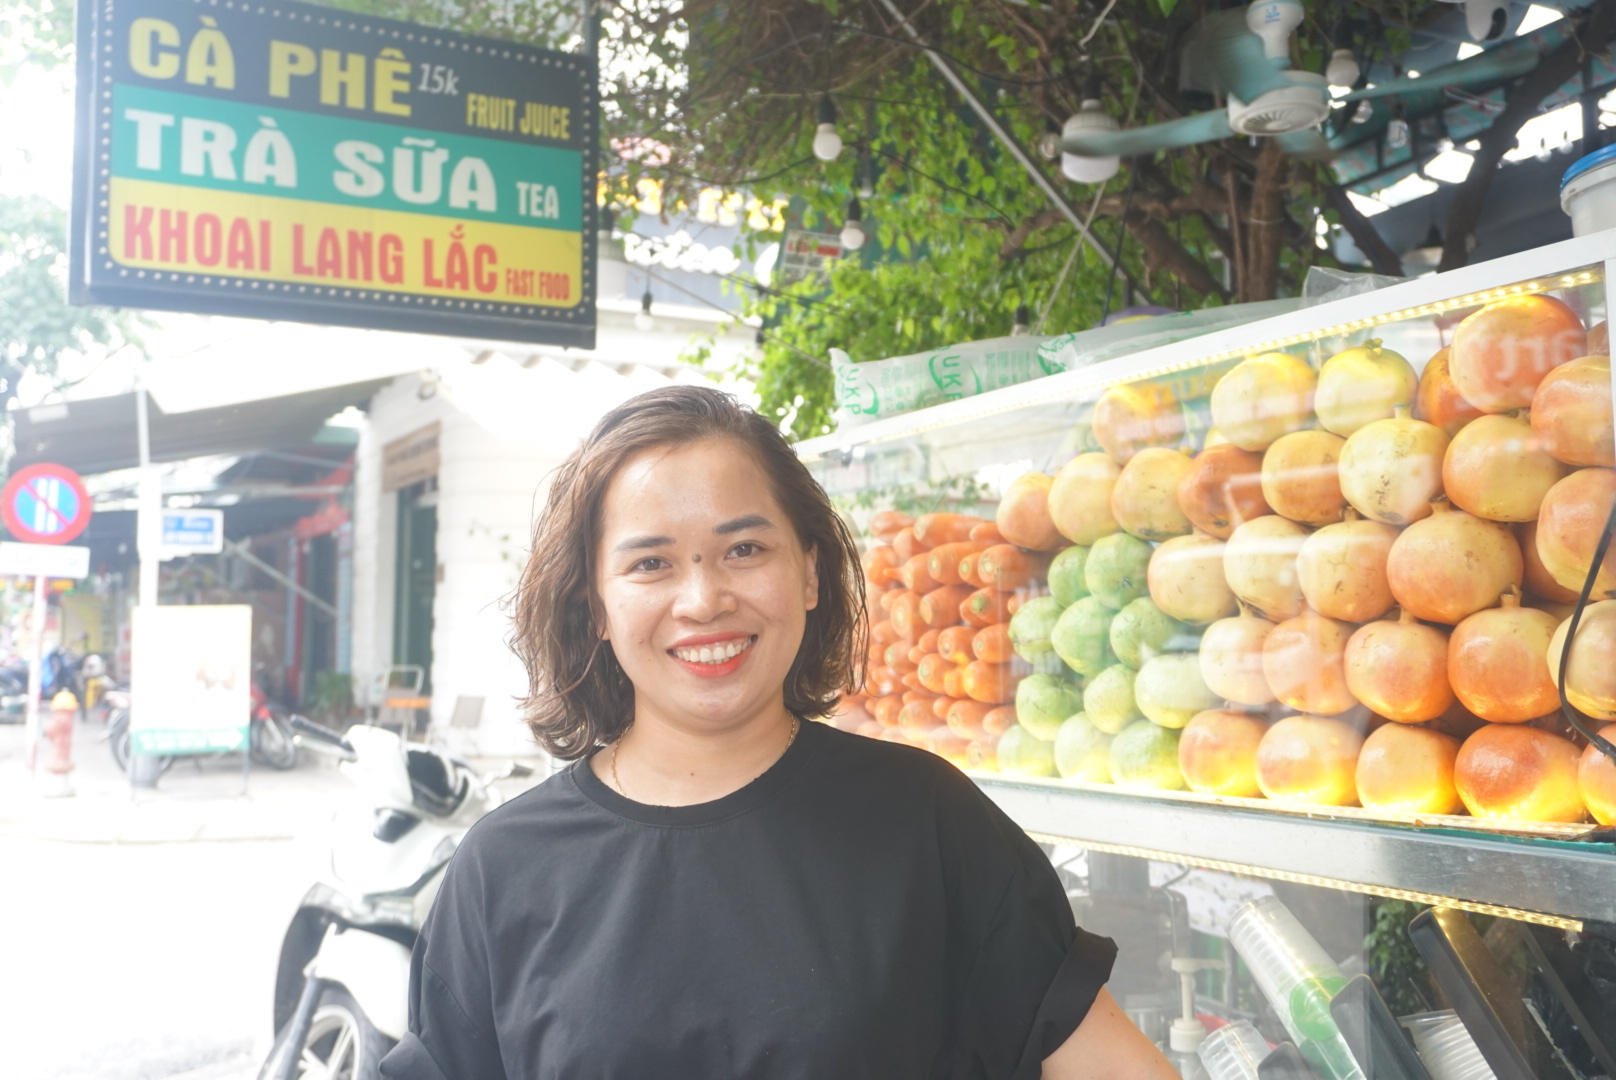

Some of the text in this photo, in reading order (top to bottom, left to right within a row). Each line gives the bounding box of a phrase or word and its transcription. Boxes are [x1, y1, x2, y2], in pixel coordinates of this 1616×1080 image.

[128, 16, 412, 117] CÀ PHÊ
[417, 63, 460, 97] 15k
[467, 93, 571, 140] FRUIT JUICE
[124, 108, 498, 213] TRÀ SỮA
[516, 181, 559, 220] TEA
[124, 204, 498, 294] KHOAI LANG LẮC
[505, 268, 571, 301] FAST FOOD
